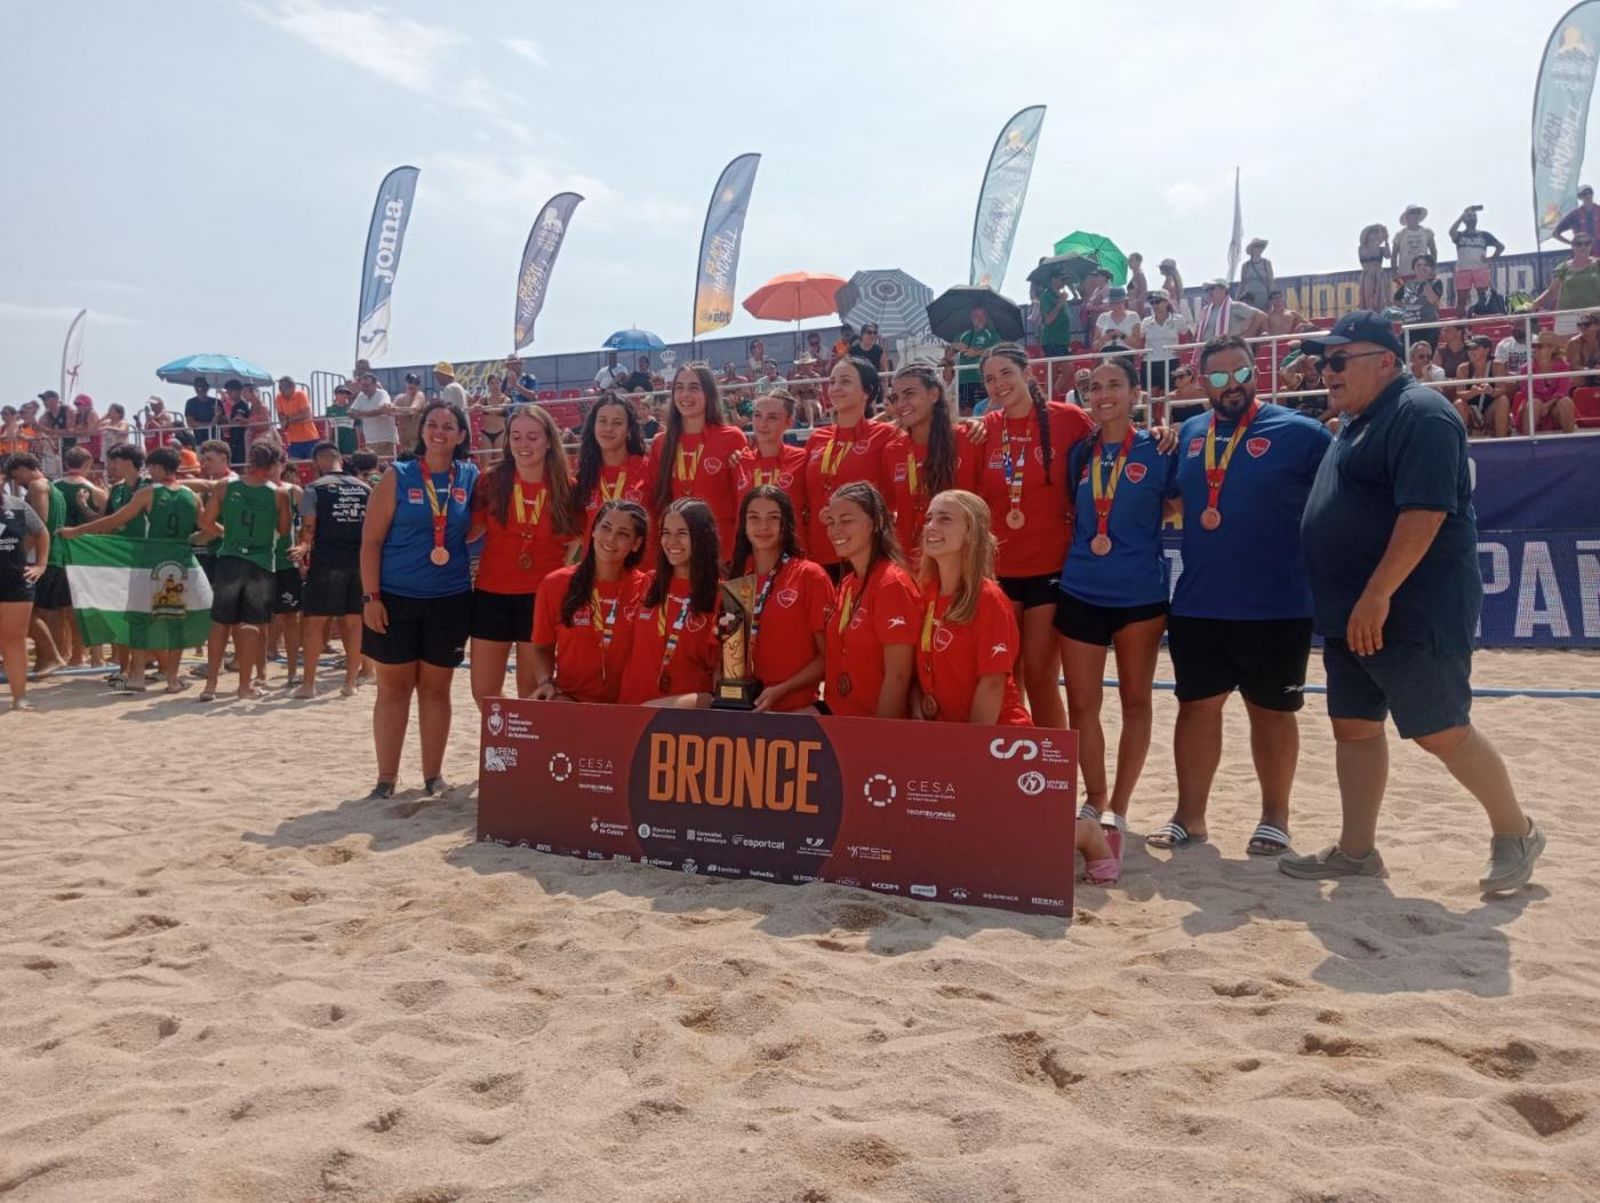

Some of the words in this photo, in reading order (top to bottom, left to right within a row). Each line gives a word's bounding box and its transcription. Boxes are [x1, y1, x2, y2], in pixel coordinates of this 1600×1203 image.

[579, 758, 613, 769] CESA
[649, 733, 822, 814] BRONCE
[907, 780, 955, 794] CESA
[743, 839, 785, 850] esportcat
